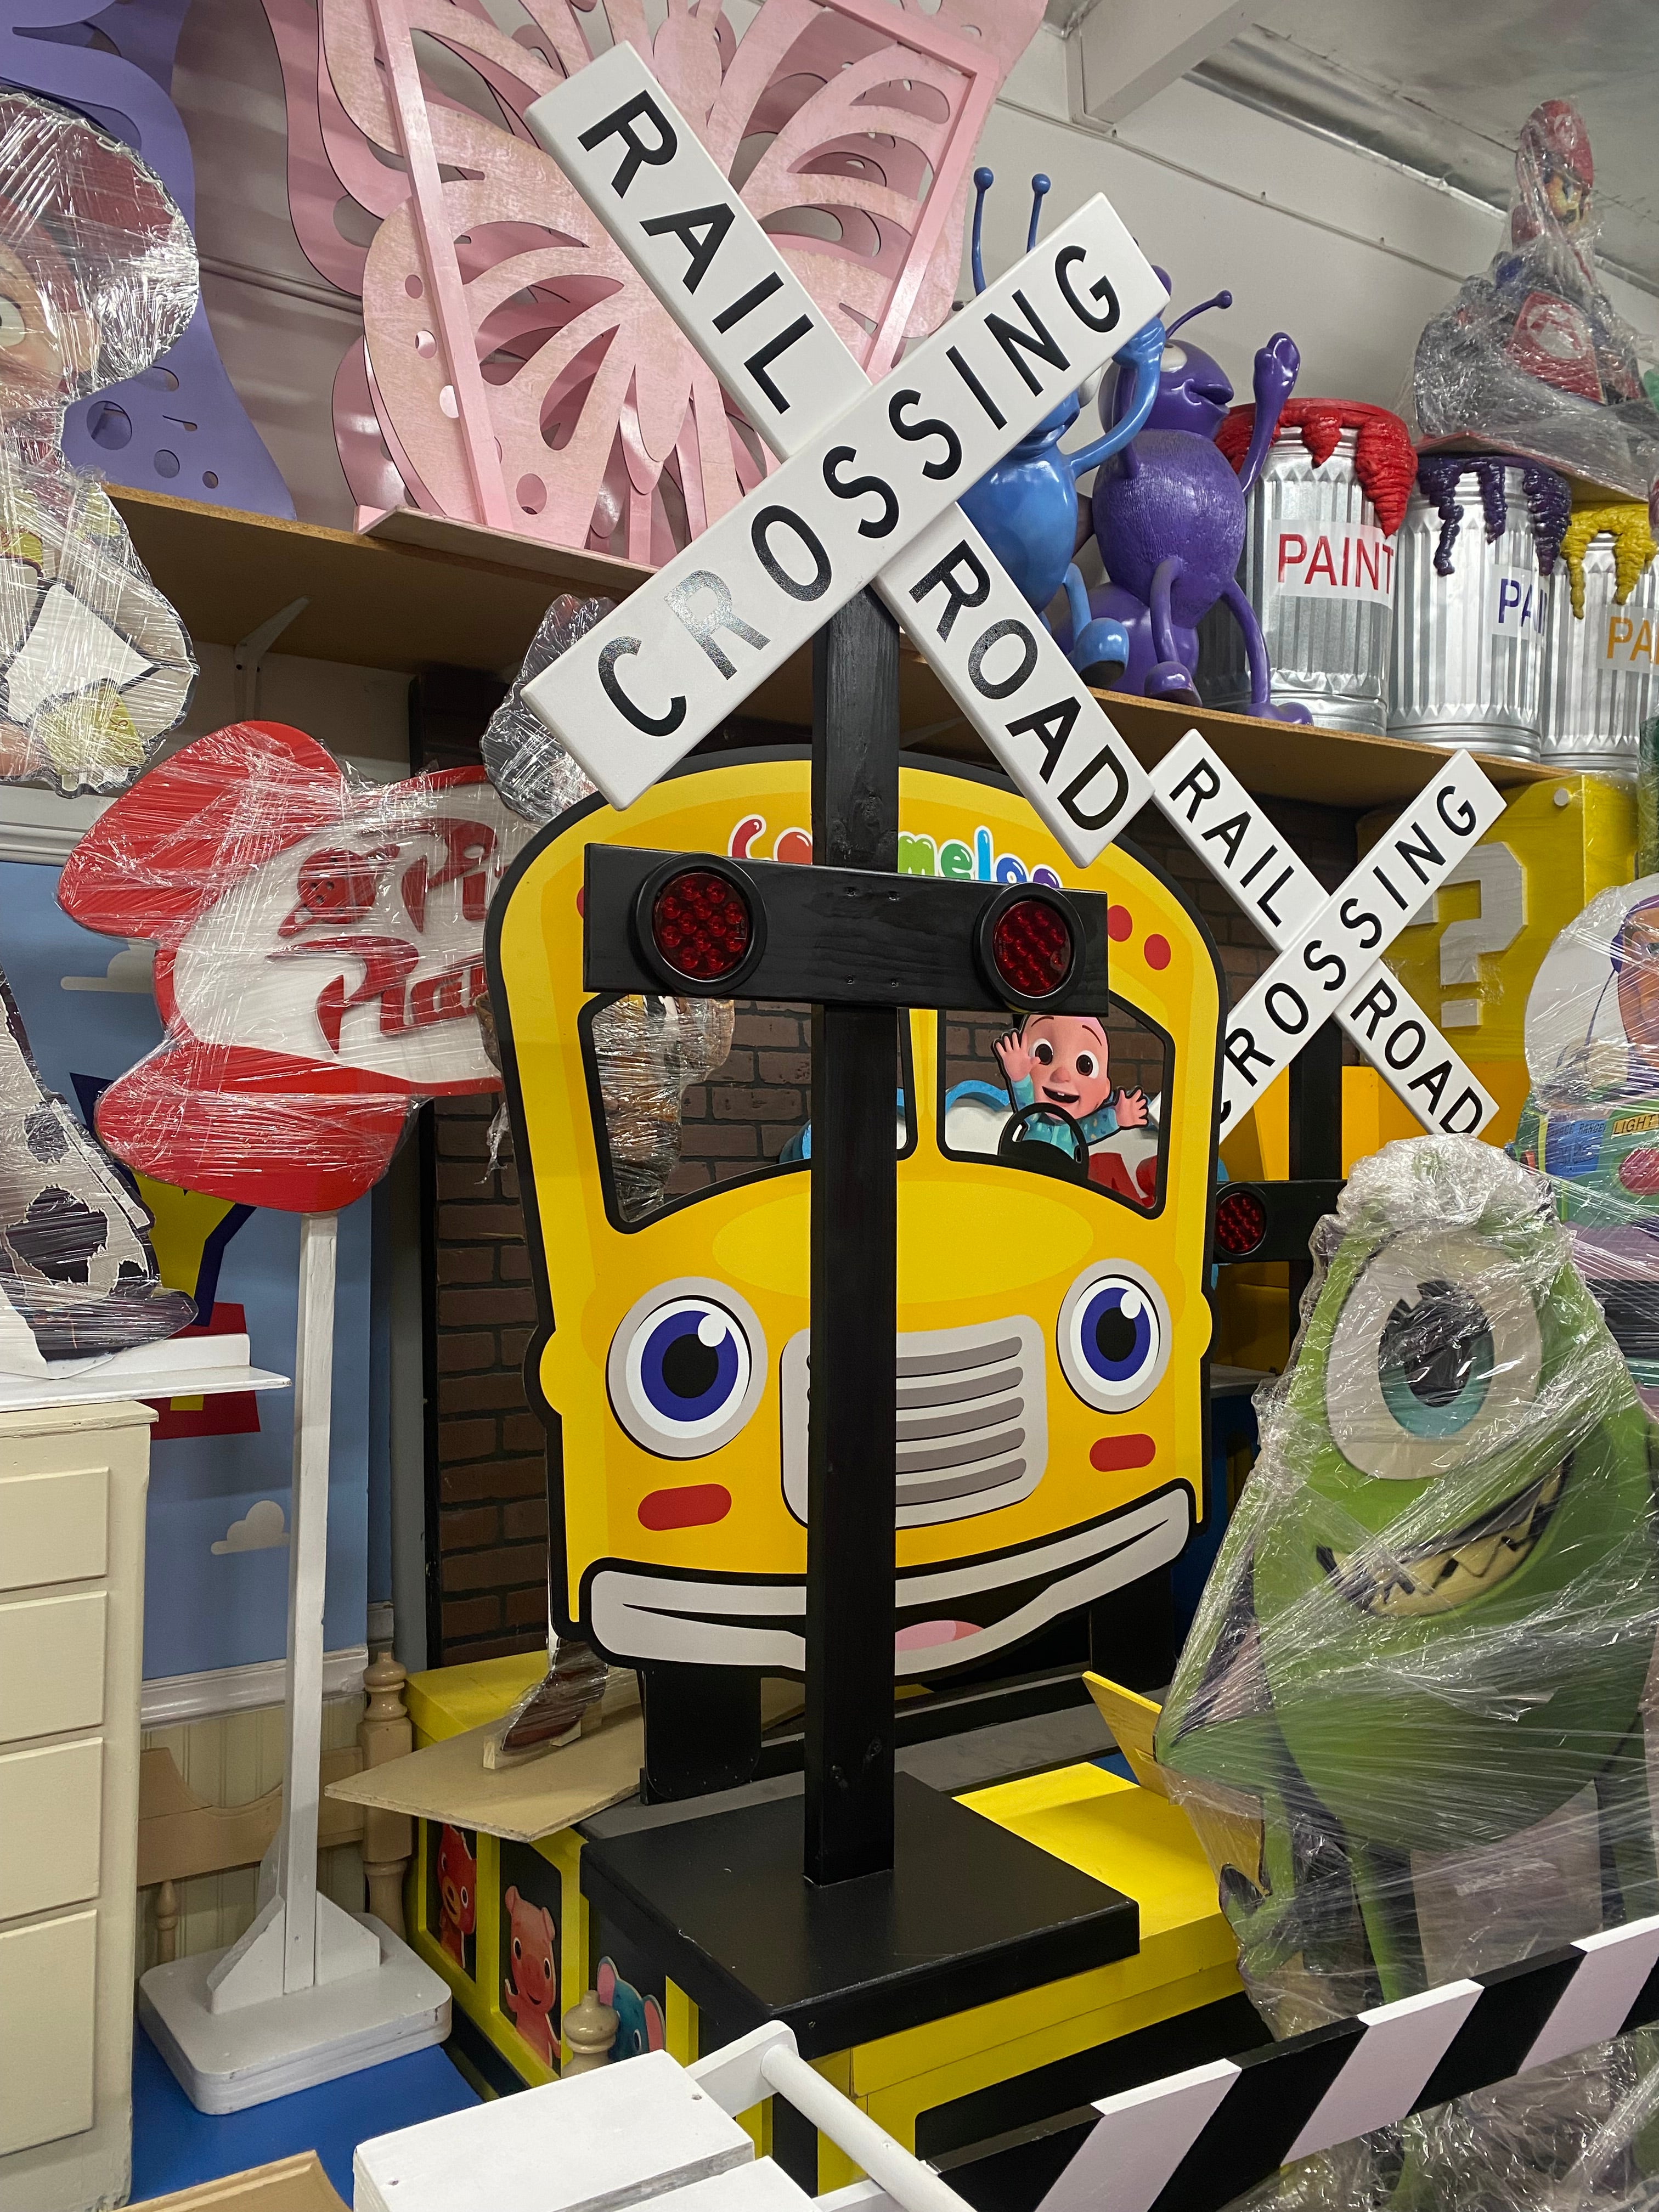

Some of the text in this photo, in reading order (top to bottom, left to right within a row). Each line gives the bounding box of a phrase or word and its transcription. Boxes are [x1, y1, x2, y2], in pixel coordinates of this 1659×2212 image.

[577, 91, 1130, 831] RAIL ROAD
[598, 245, 1121, 737] CROSSING
[1278, 534, 1393, 594] PAINT
[1170, 757, 1483, 1134] RAIL ROAD
